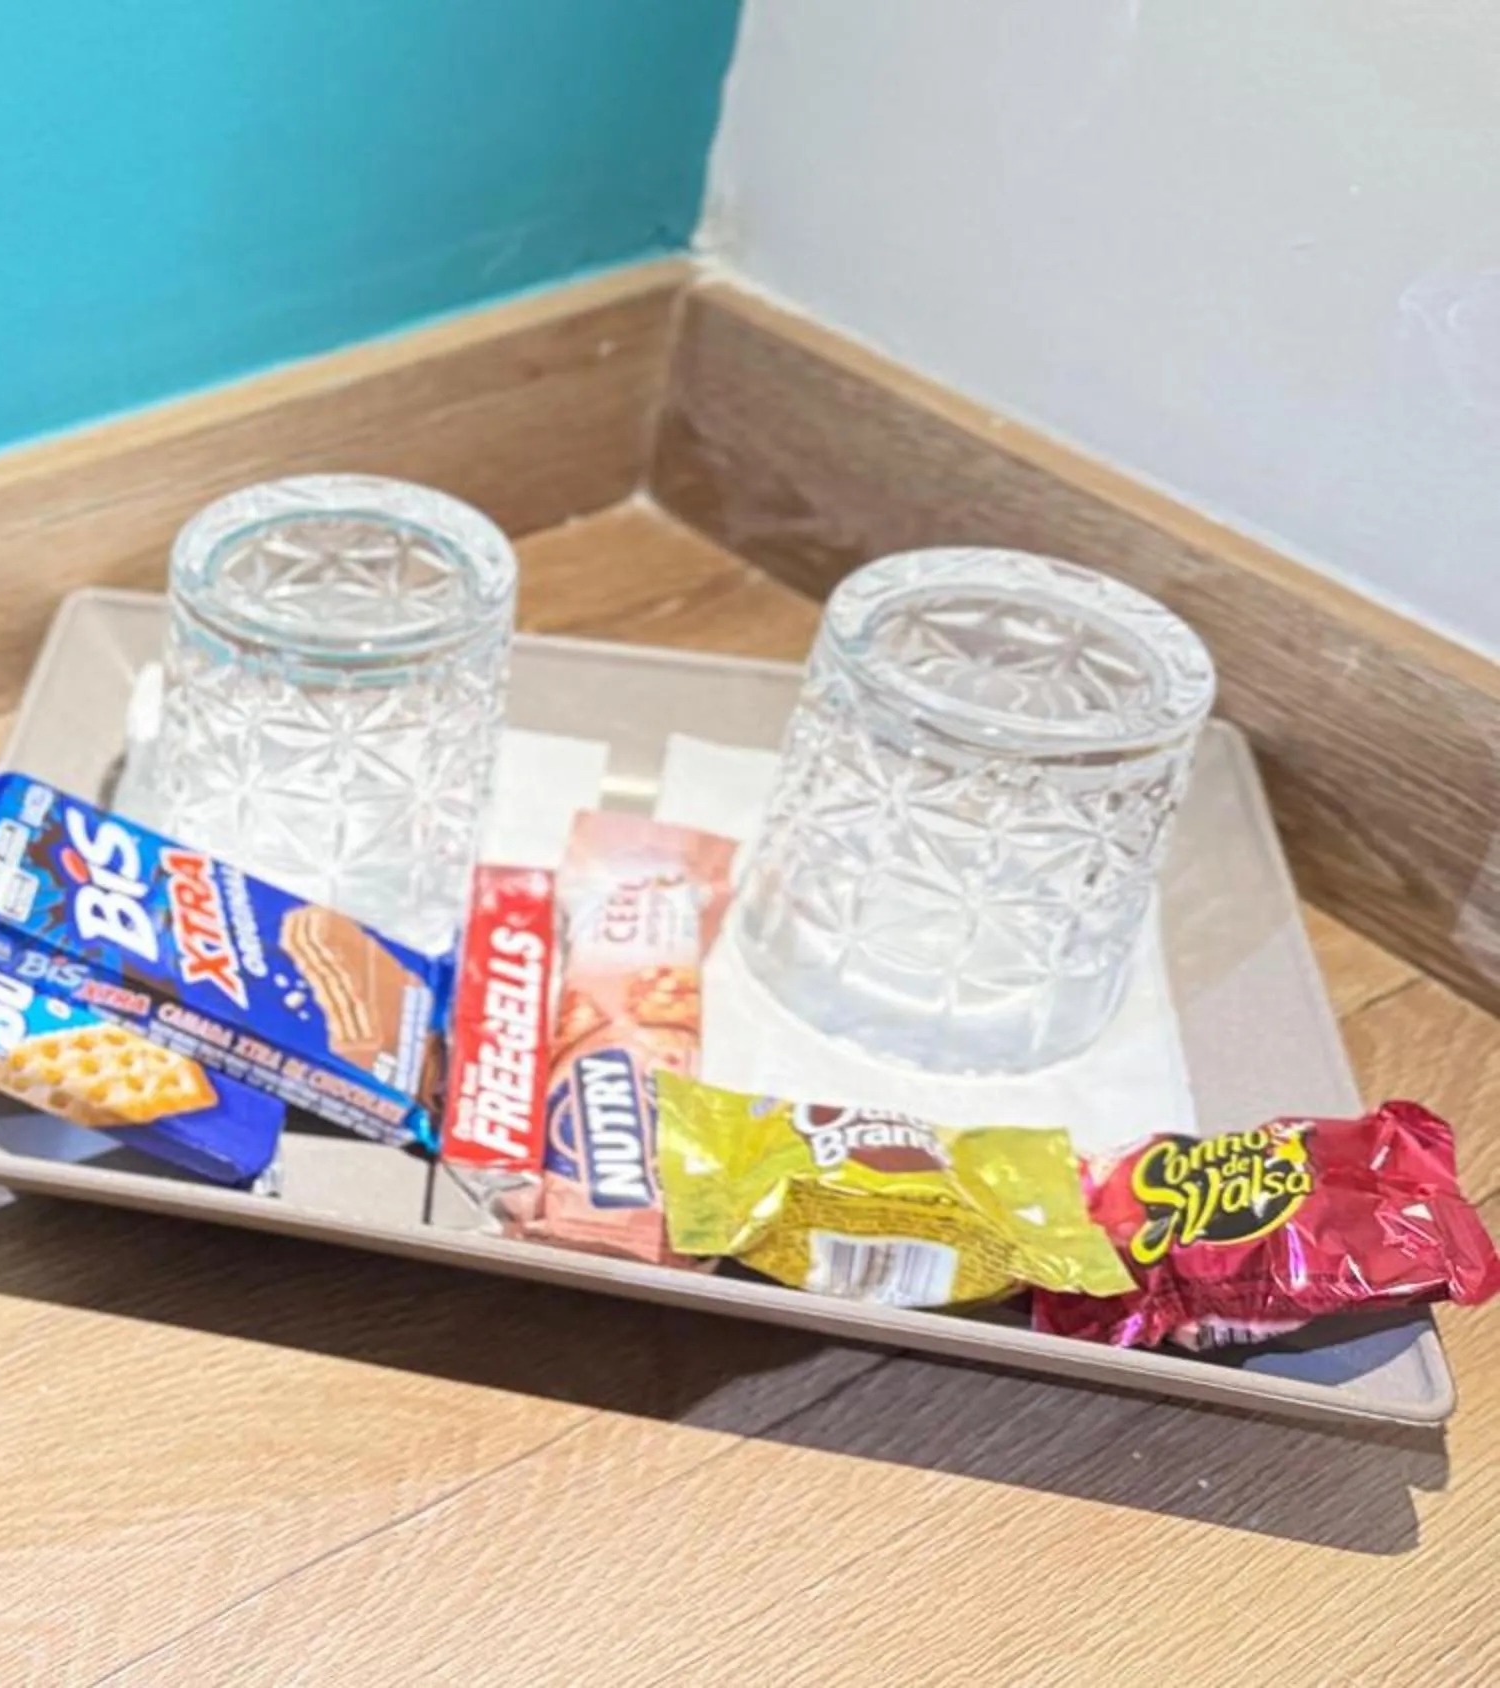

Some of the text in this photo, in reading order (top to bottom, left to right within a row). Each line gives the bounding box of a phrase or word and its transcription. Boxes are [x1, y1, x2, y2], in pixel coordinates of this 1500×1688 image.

[160, 847, 250, 1010] XTRA
[472, 926, 547, 1159] FREEGELLS
[580, 1057, 650, 1199] NUTRY
[1180, 1155, 1312, 1246] Valsa
